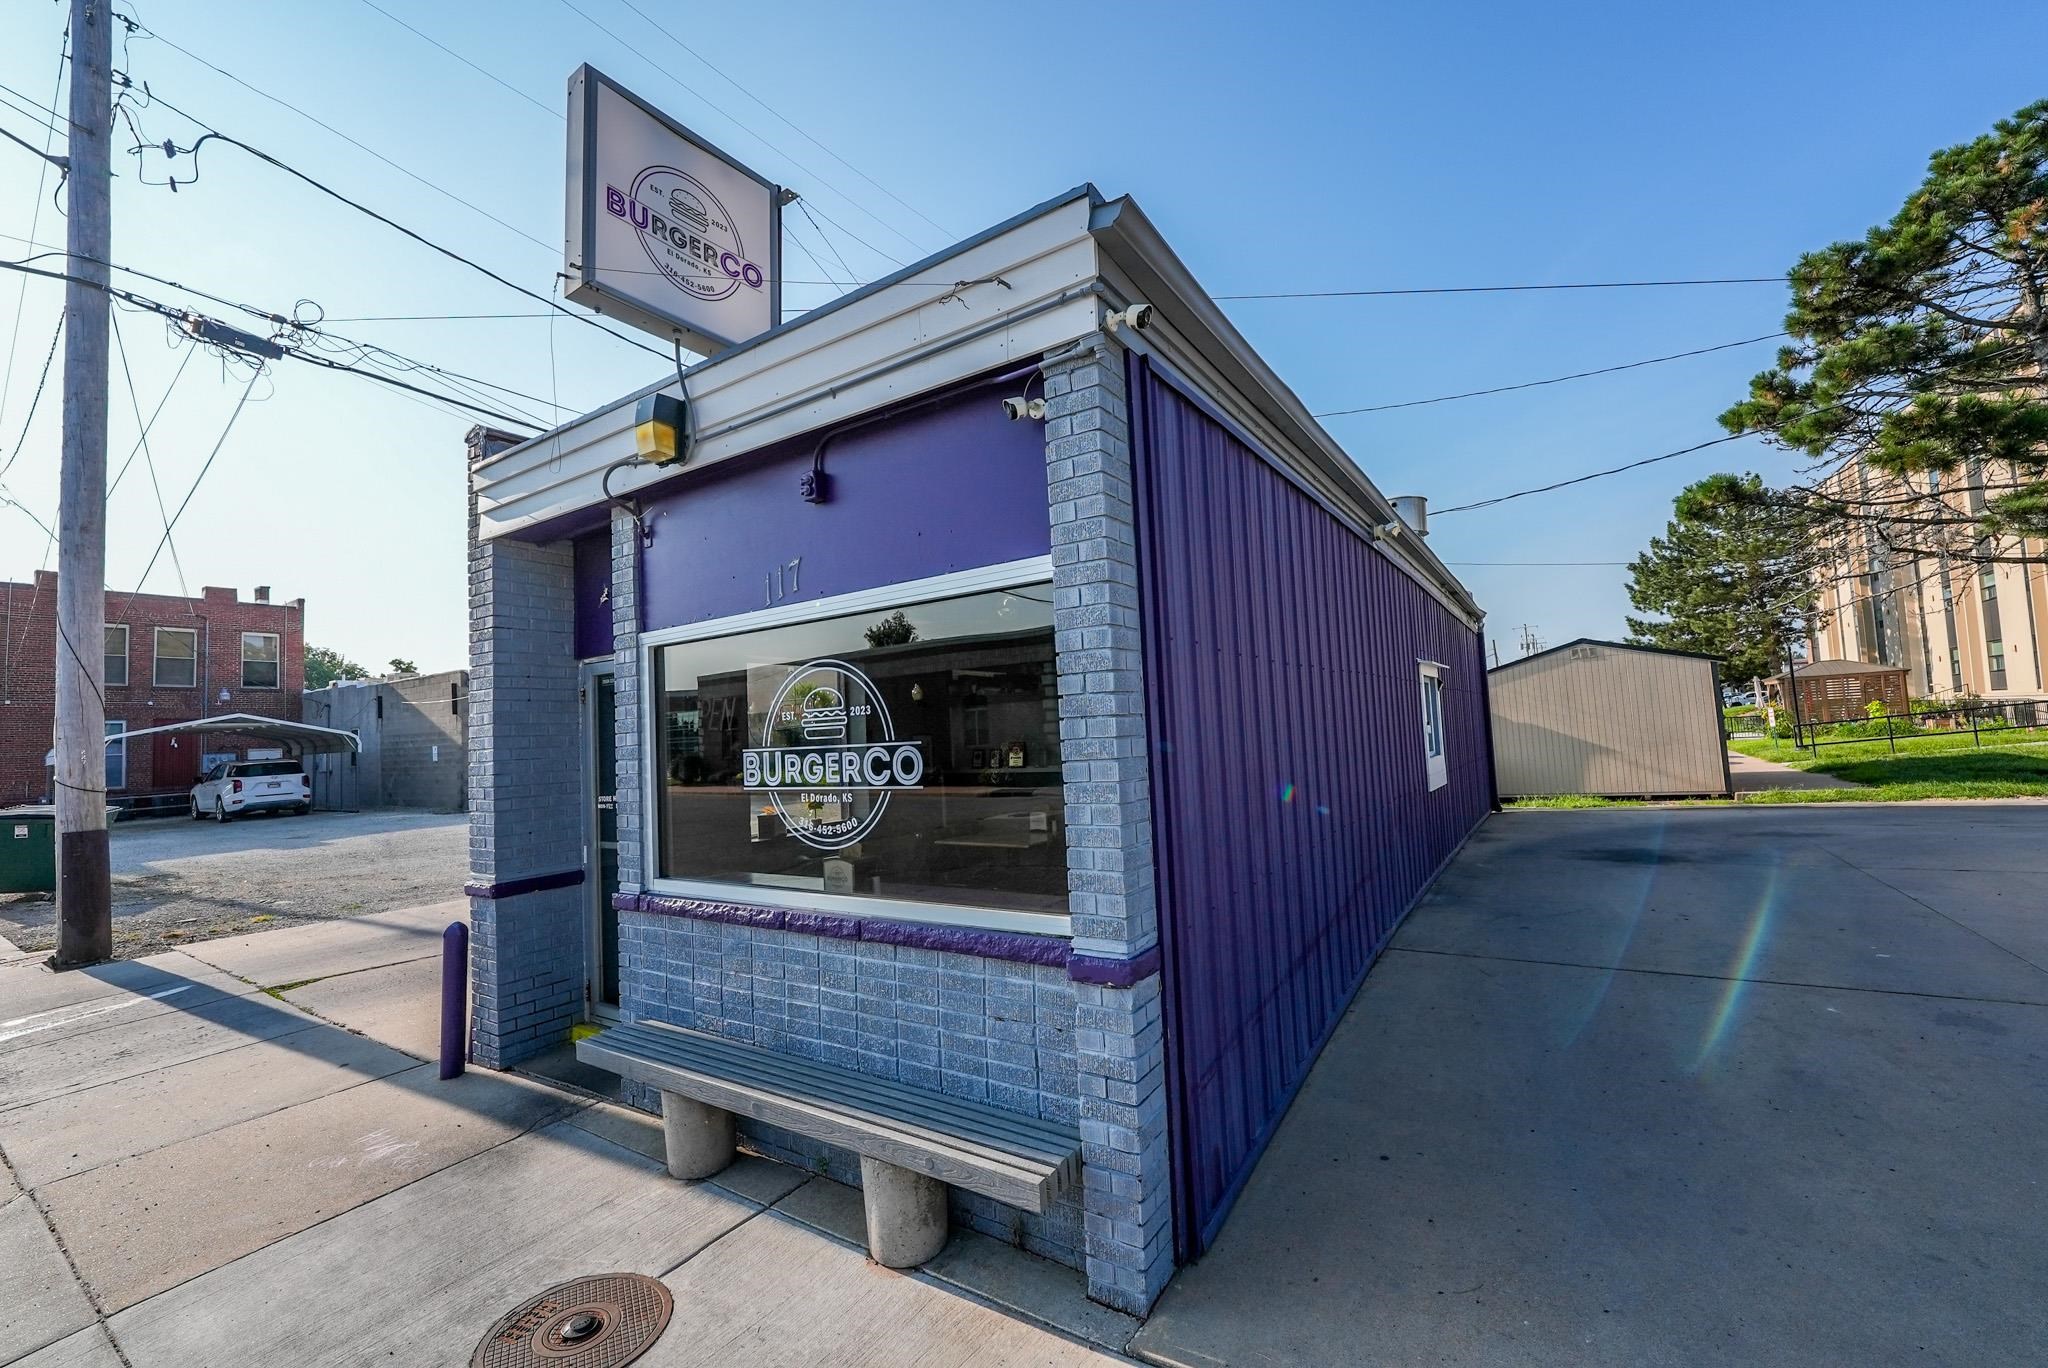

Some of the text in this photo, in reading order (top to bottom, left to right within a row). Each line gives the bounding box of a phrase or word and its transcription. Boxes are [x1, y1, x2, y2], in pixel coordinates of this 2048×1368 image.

[650, 184, 729, 233] EST. 2023
[606, 186, 763, 289] BURGERCO
[664, 262, 715, 293] 316-452-5600
[666, 248, 712, 277] El Dorado, KS
[782, 705, 871, 721] EST. 2023
[742, 746, 923, 787] BURGERCO
[801, 793, 853, 804] El Dorado, KS
[799, 817, 858, 836] 316-452-5600
